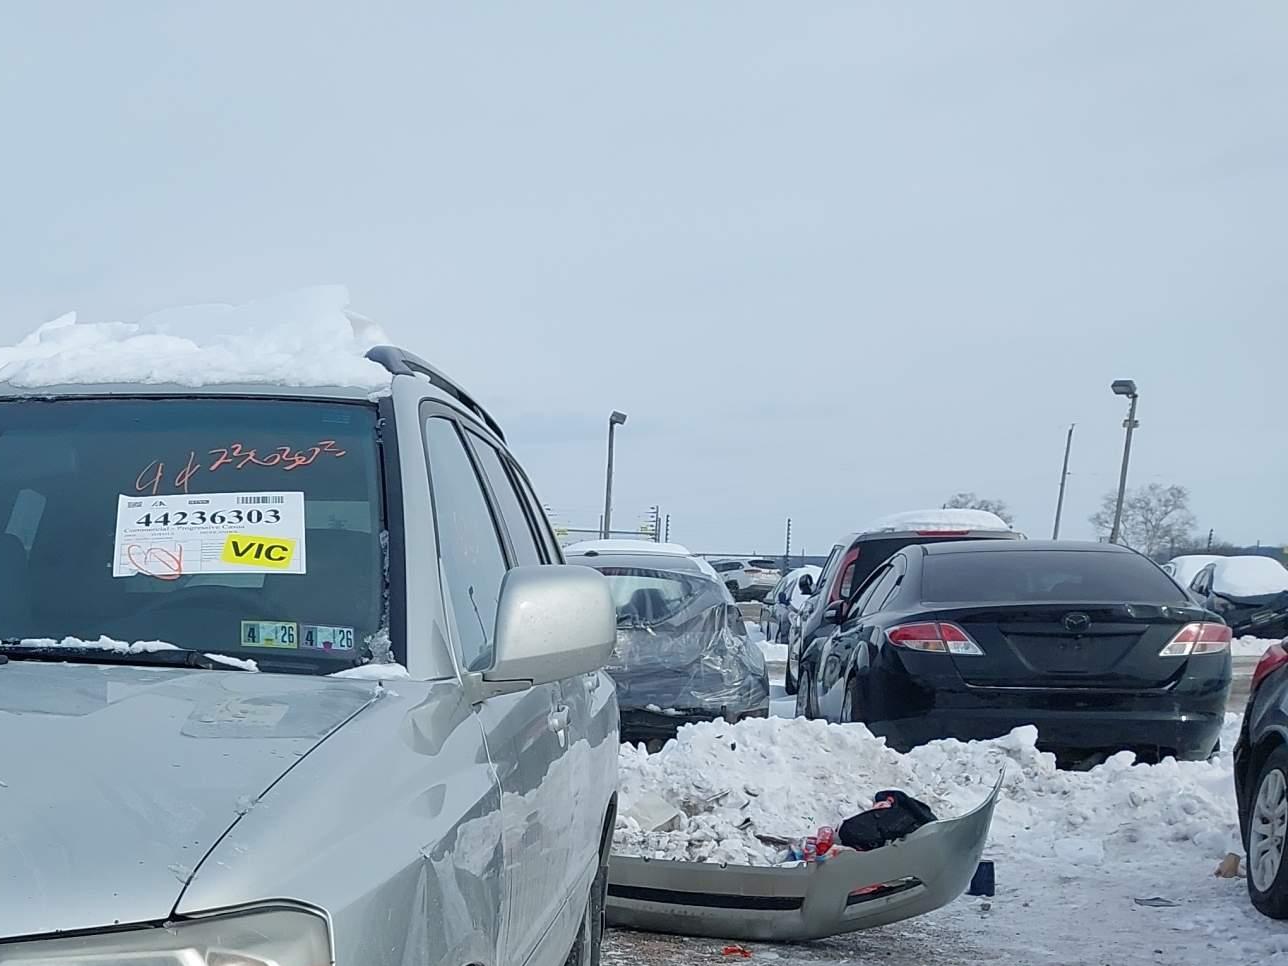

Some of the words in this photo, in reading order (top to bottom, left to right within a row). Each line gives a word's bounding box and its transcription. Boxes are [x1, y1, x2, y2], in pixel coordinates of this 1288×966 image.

[136, 508, 281, 527] 44236303
[231, 540, 289, 562] VIC
[280, 625, 295, 644] 26
[338, 629, 353, 648] 26
